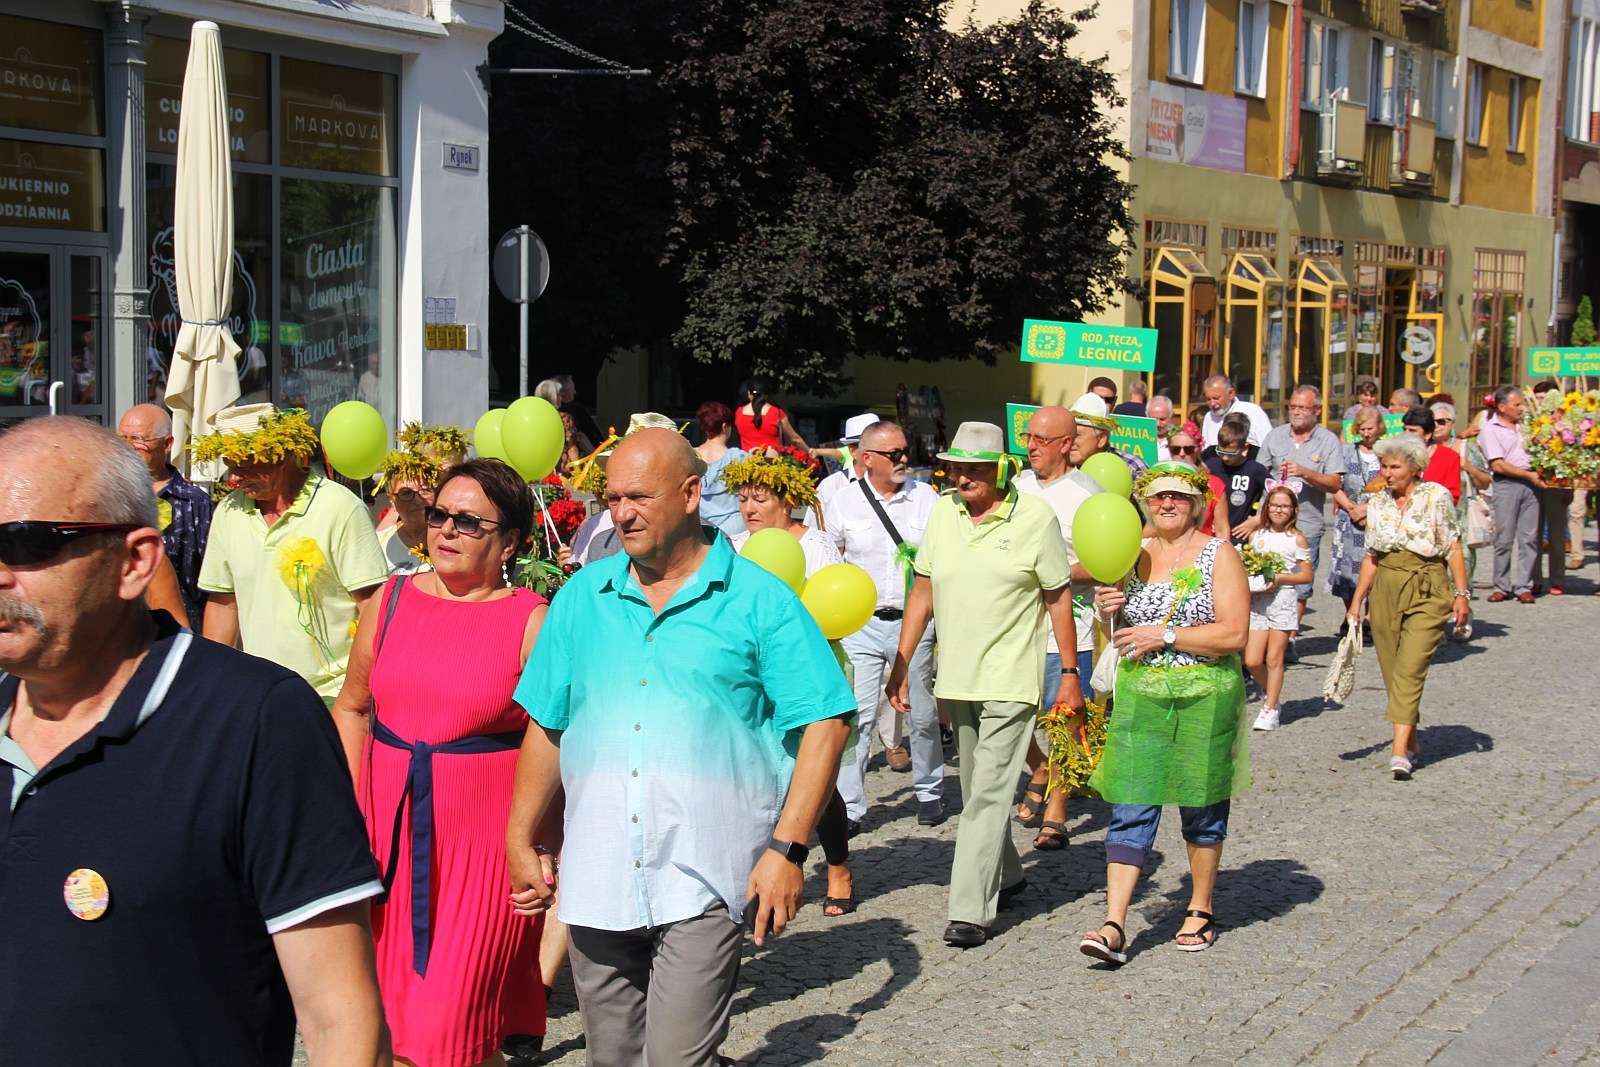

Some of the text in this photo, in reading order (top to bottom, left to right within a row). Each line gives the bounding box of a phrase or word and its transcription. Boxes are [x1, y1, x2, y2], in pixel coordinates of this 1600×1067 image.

[1151, 98, 1184, 123] FRYZJER
[295, 115, 379, 140] MARKOVA
[450, 146, 473, 167] Rynek
[305, 239, 365, 279] Ciasta
[308, 279, 367, 311] domowe
[1081, 332, 1103, 343] ROD
[291, 338, 336, 371] Kawa
[1078, 346, 1143, 364] LEGNICA
[1231, 475, 1250, 491] 03
